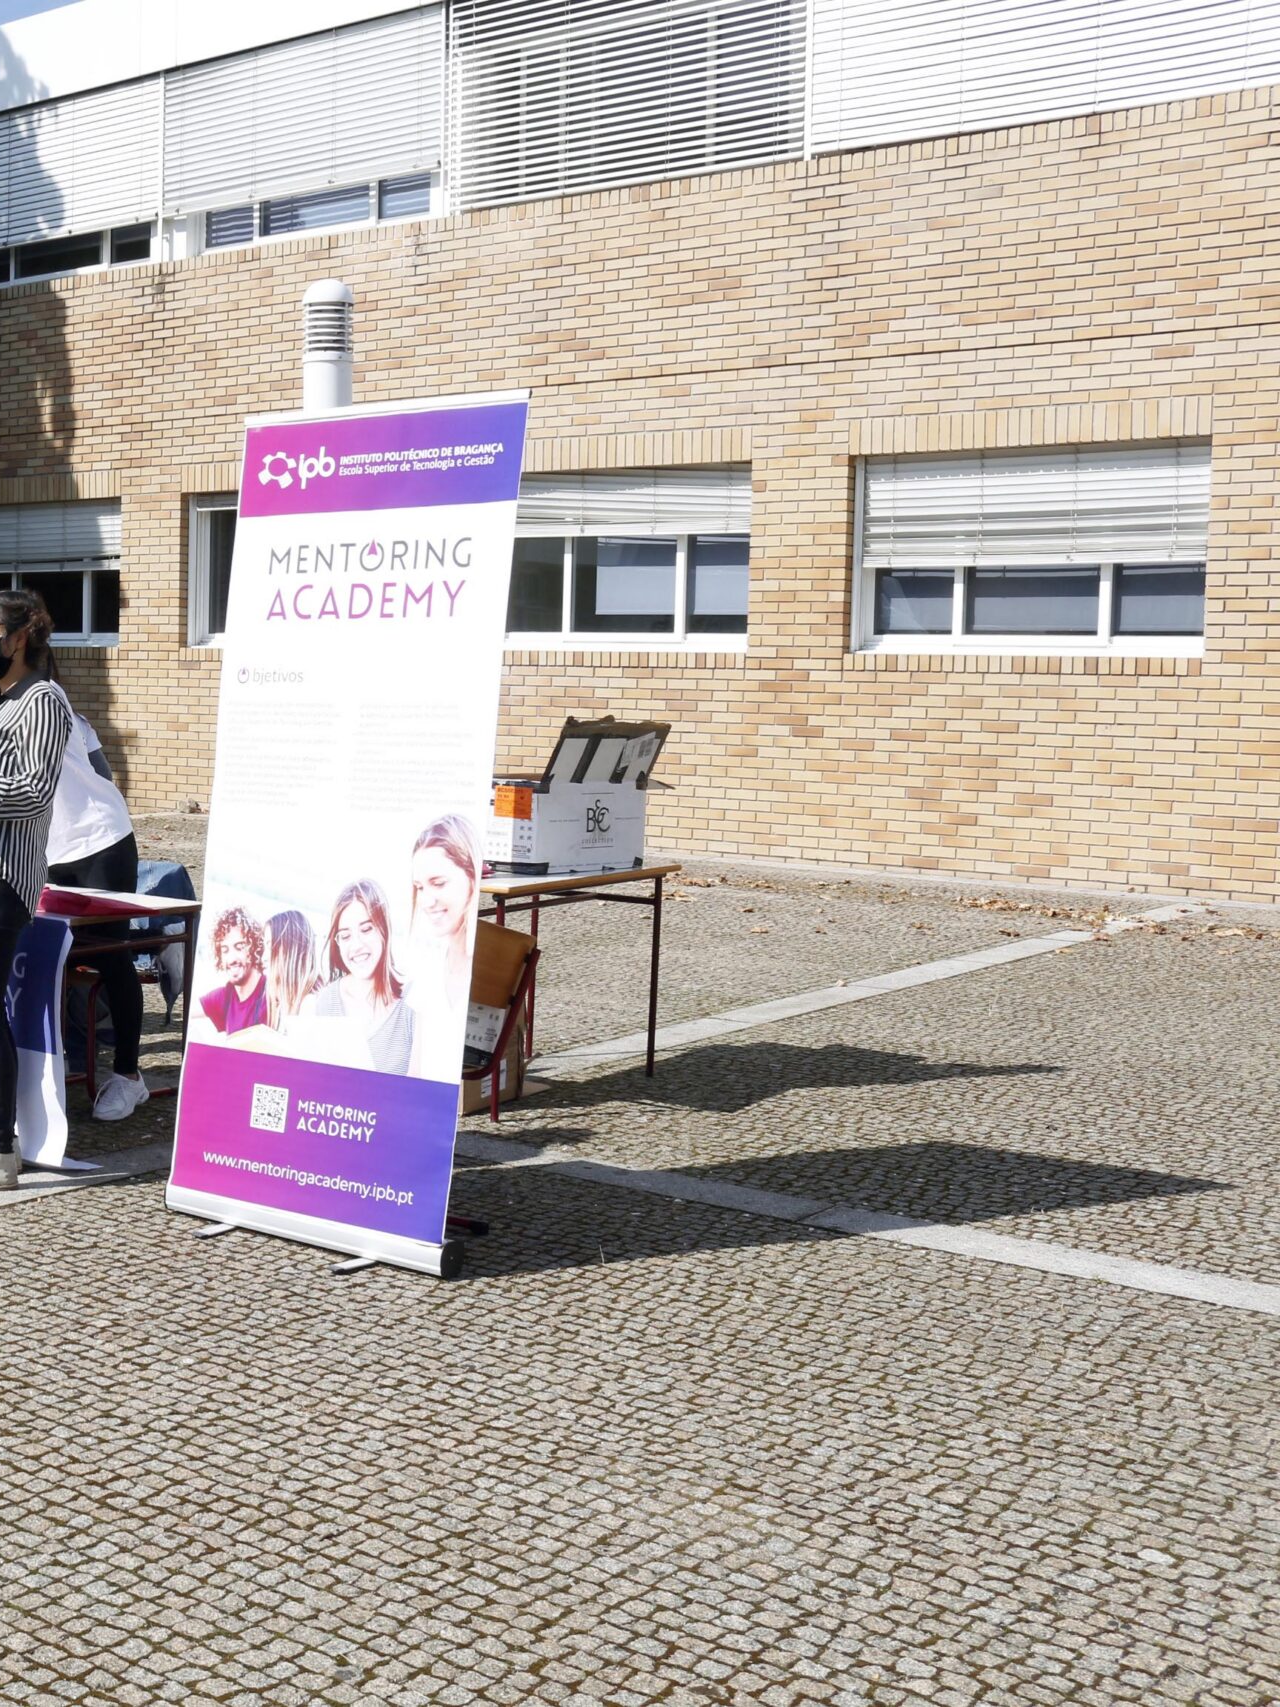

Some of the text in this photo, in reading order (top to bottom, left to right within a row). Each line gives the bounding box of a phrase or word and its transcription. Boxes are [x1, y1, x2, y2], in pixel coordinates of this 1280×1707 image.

[298, 446, 336, 490] ipb
[339, 454, 495, 476] Escola Superior de Tecnologia e Gestão
[340, 442, 504, 466] INSTITUTO POLITÉCNICO DE BRAGANÇA
[268, 537, 472, 575] MENTORING
[266, 579, 466, 621] ACADEMY
[586, 800, 611, 832] B&C
[298, 1099, 376, 1126] MENTORING
[296, 1116, 374, 1143] ACADEMY
[203, 1151, 414, 1206] www.mentoringacademy.ipb.pt
